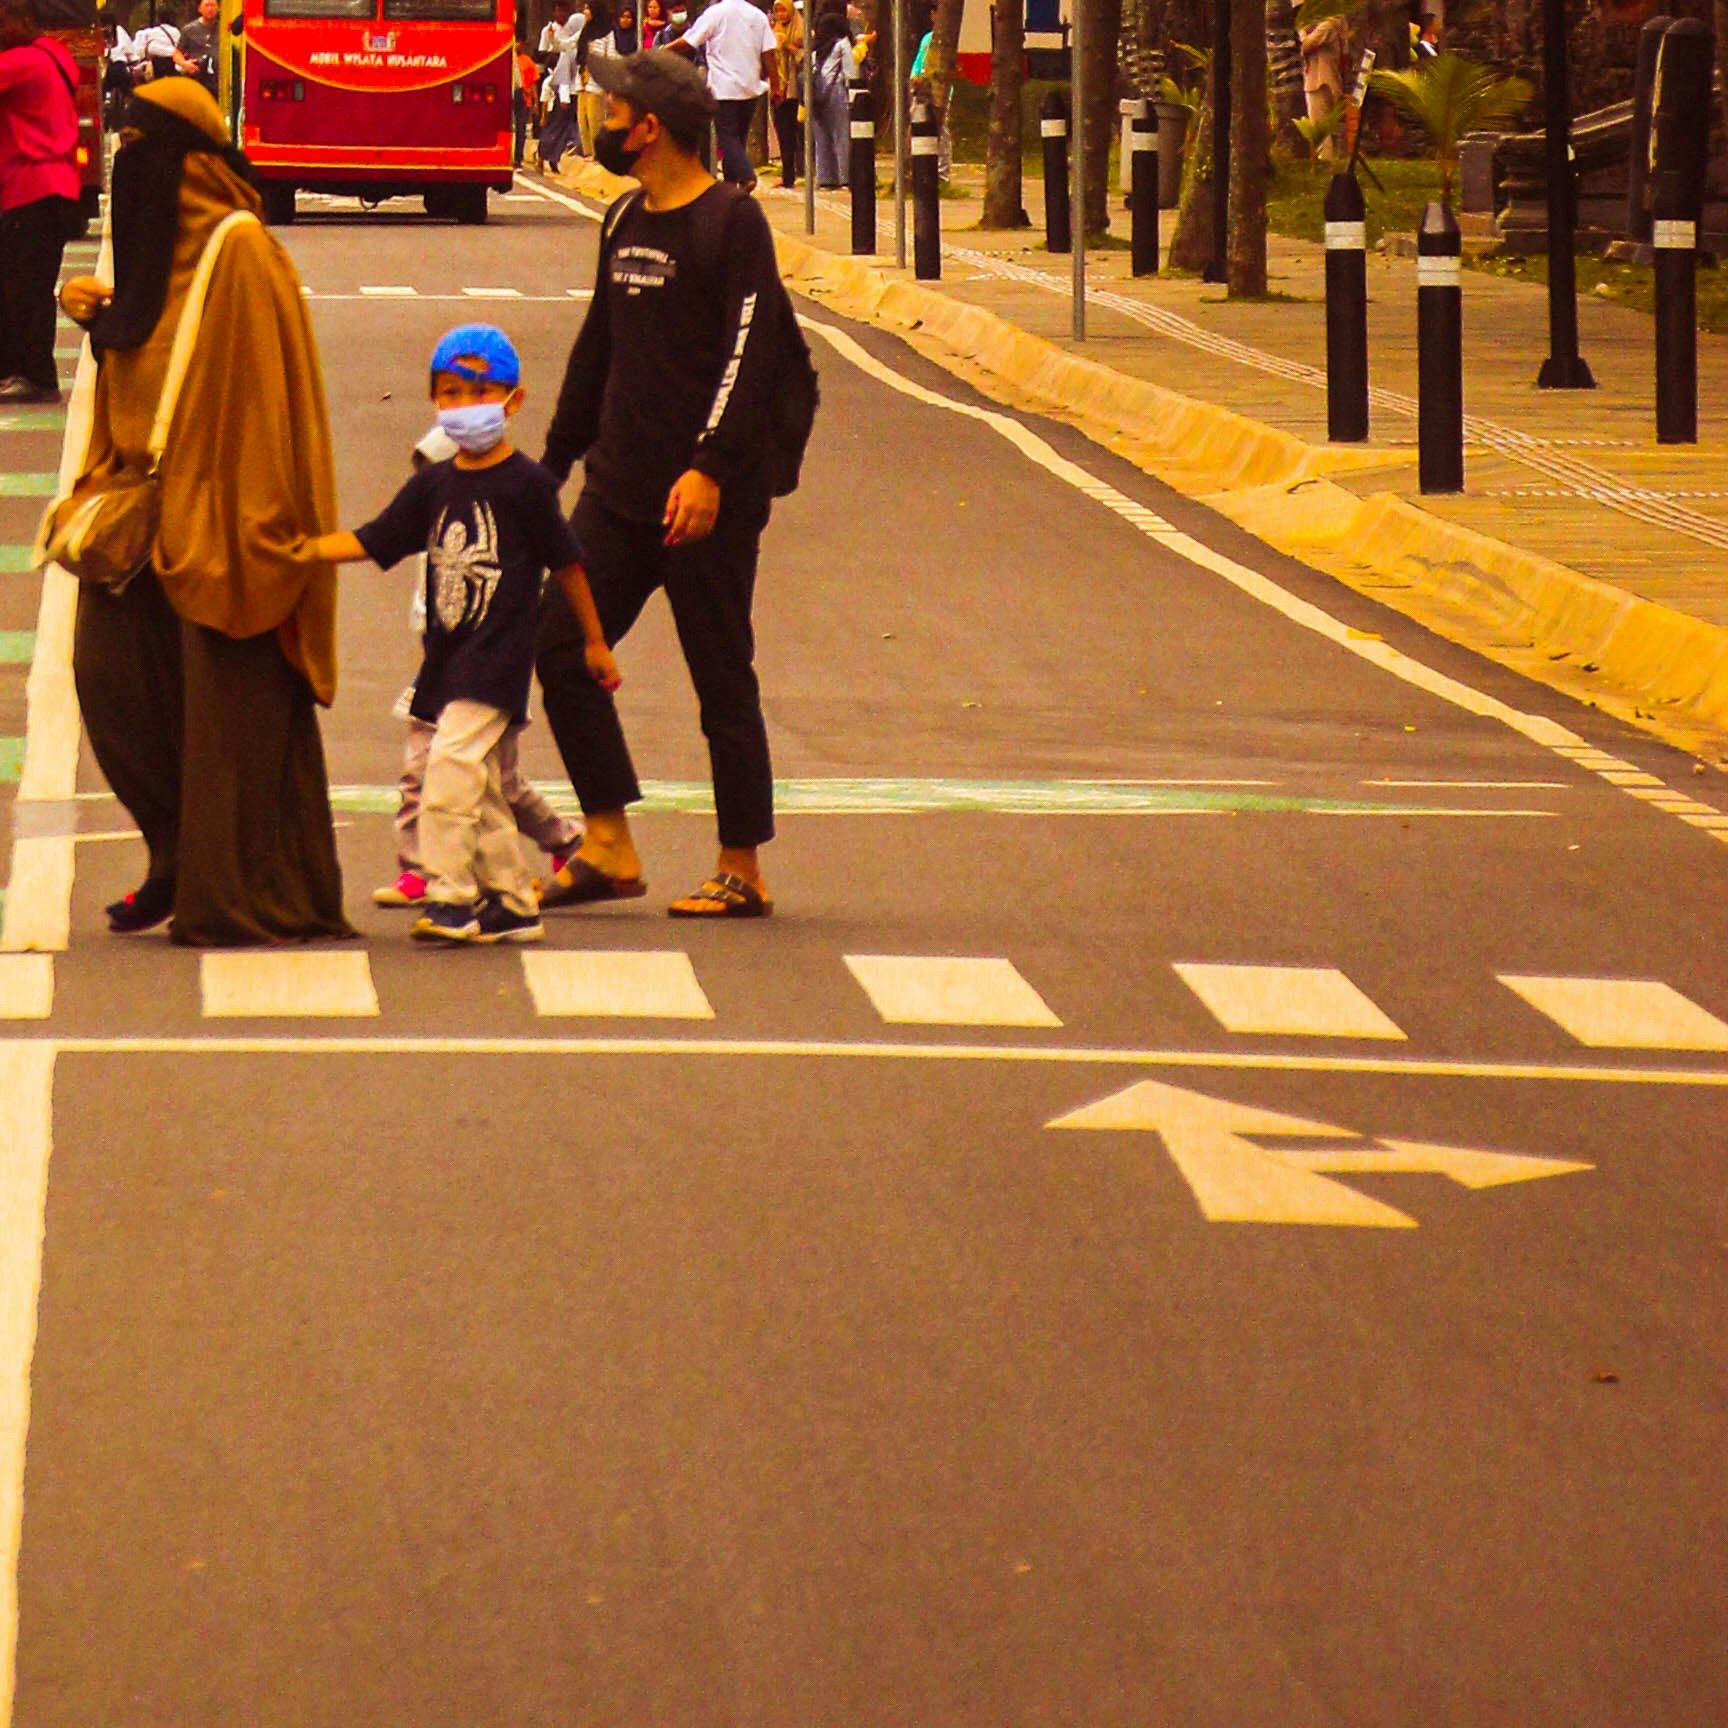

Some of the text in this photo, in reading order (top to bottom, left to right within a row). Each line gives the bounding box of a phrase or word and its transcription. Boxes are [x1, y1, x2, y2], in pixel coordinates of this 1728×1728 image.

[310, 52, 447, 67] MOBIL WISATA NUSANTARA
